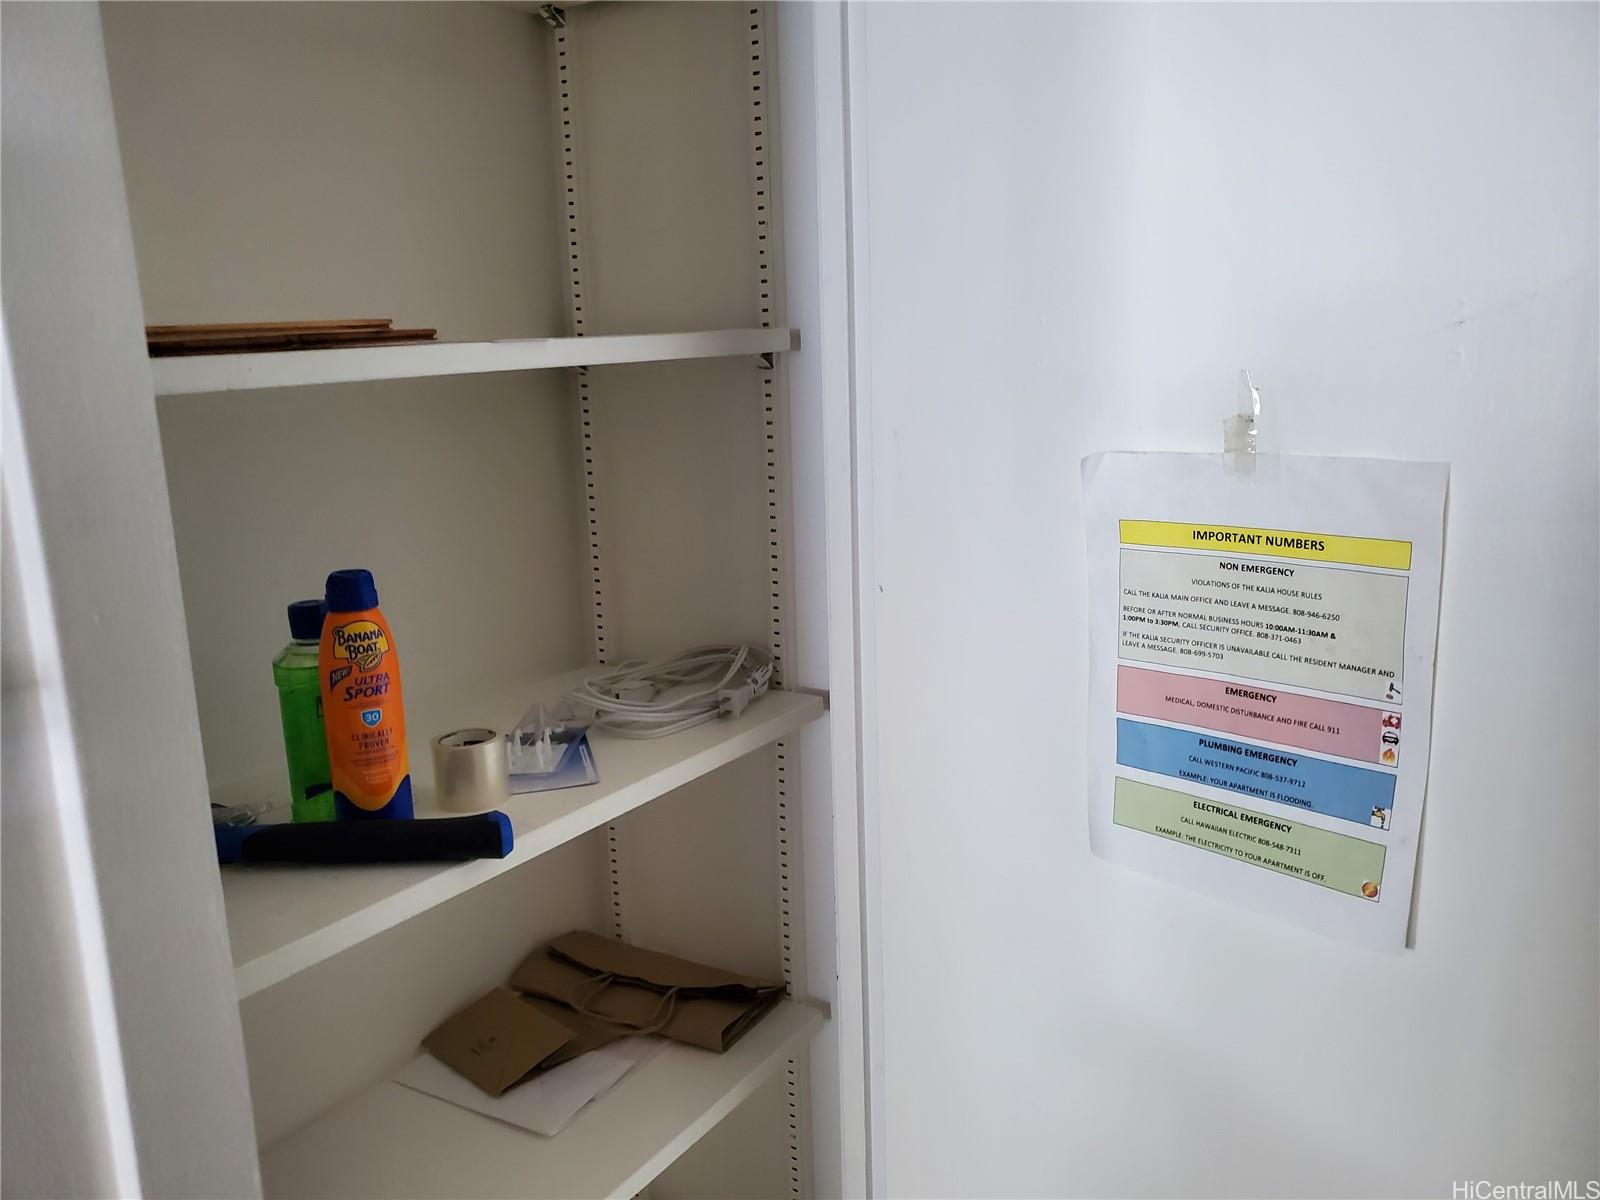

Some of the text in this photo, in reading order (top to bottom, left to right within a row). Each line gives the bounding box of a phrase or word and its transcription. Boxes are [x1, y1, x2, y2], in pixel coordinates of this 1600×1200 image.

[1193, 531, 1324, 551] IMPORTANT NUMBERS
[1220, 562, 1294, 576] NON EMERGENCY
[1192, 579, 1230, 588] VIOLATIONS
[1257, 586, 1275, 595] KALIA
[1277, 589, 1299, 597] HOUSE
[1301, 592, 1322, 600] RULES
[1191, 596, 1212, 604] OFFICE
[1231, 601, 1250, 609] LEAVE
[1293, 609, 1340, 621] 808-946-6250
[1178, 612, 1207, 621] NORMAL
[1209, 616, 1239, 625] BUSINESS
[1241, 620, 1264, 628] HOURS
[1266, 624, 1328, 638] 10:00AM-11:30AM
[1200, 624, 1229, 634] SECURITY
[1257, 632, 1301, 644] 808-371-0463
[334, 628, 383, 646] BANANA
[345, 643, 379, 660] BOAT
[1160, 636, 1190, 645] SECURITY
[1191, 640, 1217, 648] OFFICER
[1227, 645, 1269, 658] UNAVAILABLE
[1290, 655, 1302, 663] THE
[1304, 657, 1337, 668] RESIDENT
[1339, 664, 1376, 675] MANAGER
[1378, 670, 1394, 678] AND
[1180, 649, 1223, 659] 808-699-5703
[355, 673, 389, 685] ULTRA
[344, 684, 390, 701] SPORT
[1226, 687, 1277, 703] EMERGENCY
[365, 712, 379, 721] 30
[1165, 696, 1339, 734] MEDICAL, DOMESTIC DISTURBANCE AND FIRE CALL 911
[352, 728, 393, 741] CLINICALLY
[359, 738, 389, 750] PROVEN
[1199, 739, 1297, 767] PLUMBING EMERGENCY
[1189, 755, 1305, 788] CALL WESTERN PACIFIC 808-537-9712
[1179, 770, 1209, 783] EXAMPLE:
[1210, 777, 1228, 787] YOUR
[1229, 782, 1268, 797] APARTMENT
[1277, 793, 1313, 809] FLOODING.
[1194, 801, 1292, 833] ELECTRICAL EMERGENCY
[1181, 816, 1301, 855] CALL HAWAIIAN ELECTRIC 808-548-7311
[1156, 826, 1184, 840] EXAMPLE:
[1185, 834, 1196, 843] THE
[1198, 839, 1233, 854] ELECTRICITY
[1235, 848, 1243, 856] TO
[1245, 852, 1261, 862] YOUR
[1263, 857, 1303, 875] APARTMENT
[1312, 873, 1326, 883] OFF.
